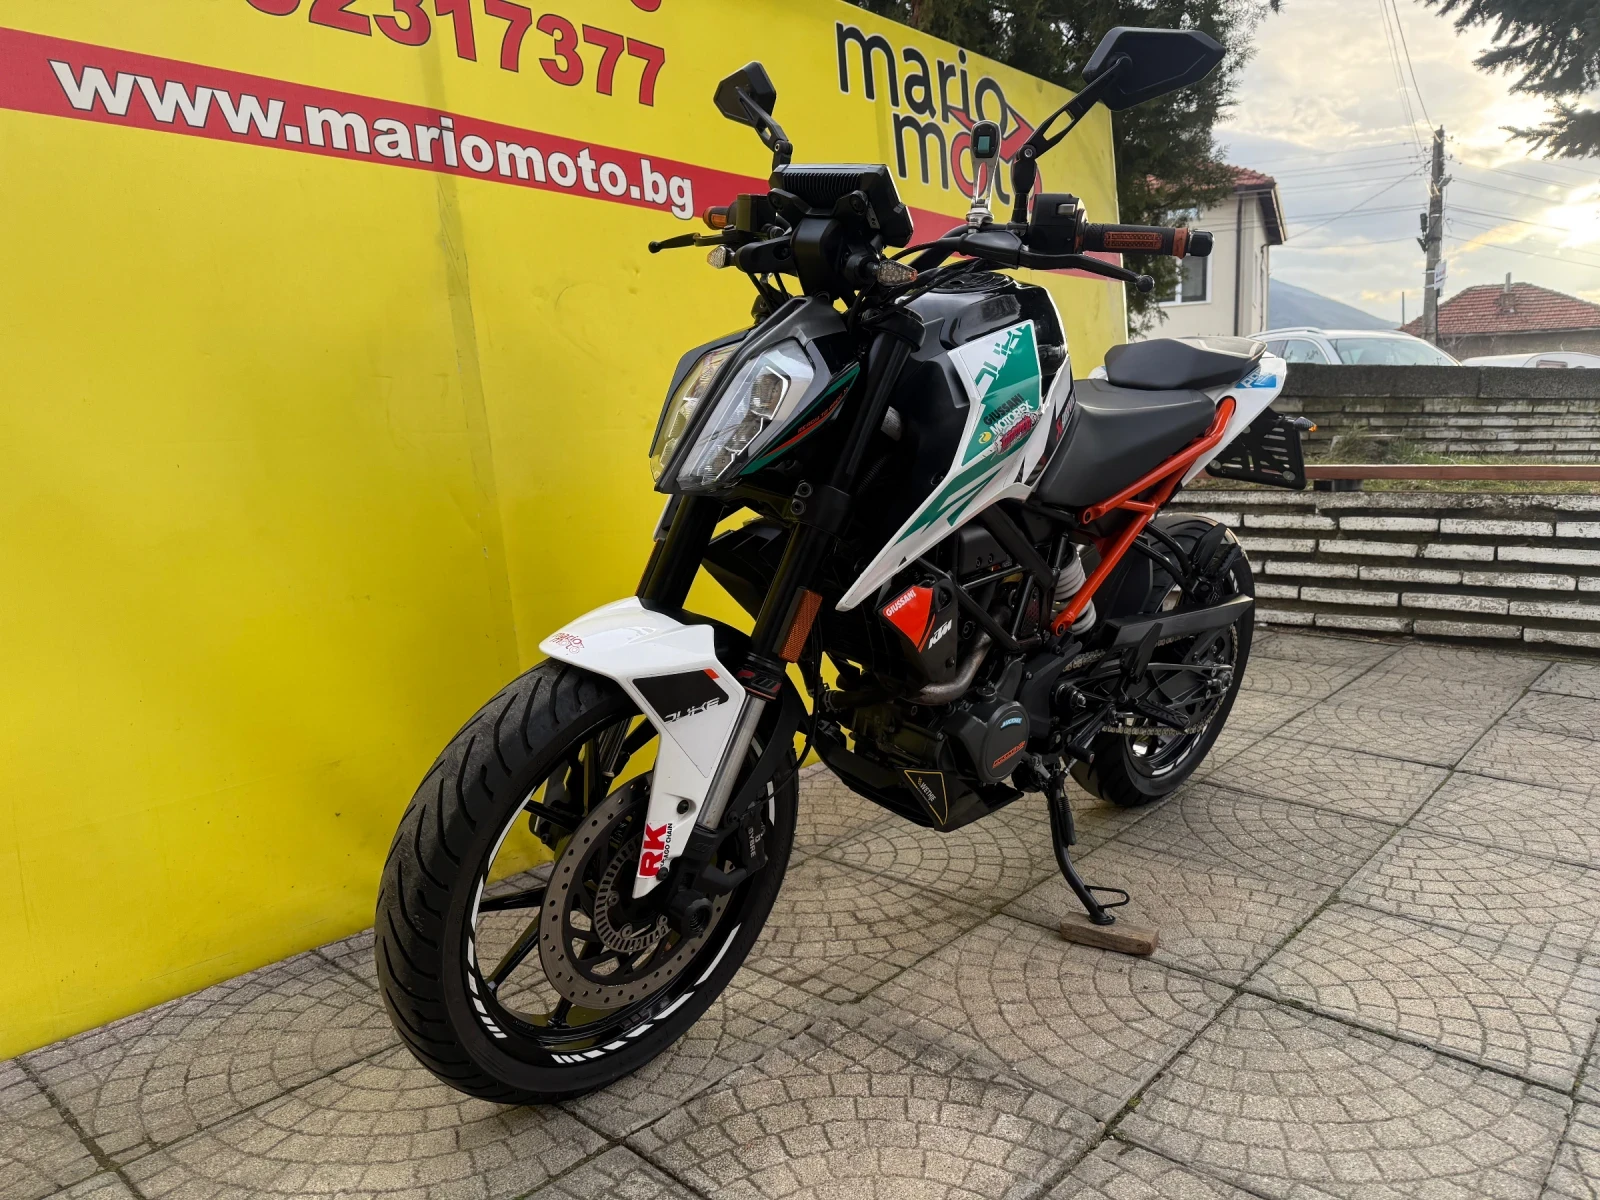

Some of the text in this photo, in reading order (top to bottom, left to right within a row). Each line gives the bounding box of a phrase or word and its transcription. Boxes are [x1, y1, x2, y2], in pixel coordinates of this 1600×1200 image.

[246, 0, 666, 107] 317377
[836, 22, 1008, 136] mario
[48, 58, 695, 221] www.mariomoto.bg
[983, 392, 1025, 426] GIUSSANI
[885, 589, 917, 617] GIUSSANI
[927, 618, 953, 650] KTM
[639, 823, 668, 877] RK
[665, 822, 673, 843] CHAIN
